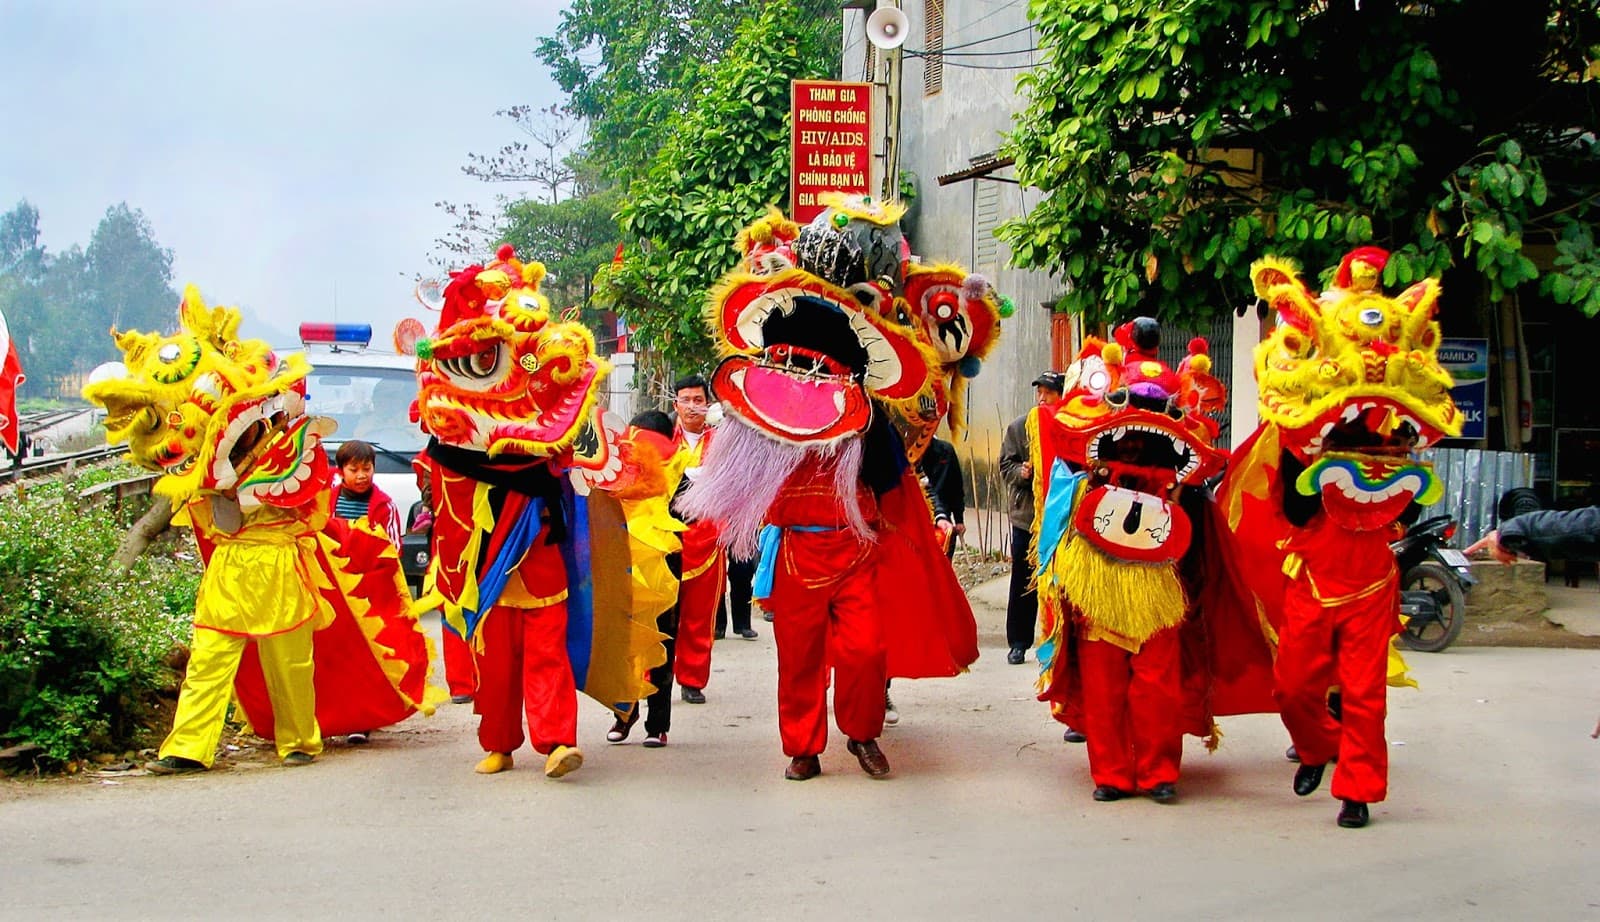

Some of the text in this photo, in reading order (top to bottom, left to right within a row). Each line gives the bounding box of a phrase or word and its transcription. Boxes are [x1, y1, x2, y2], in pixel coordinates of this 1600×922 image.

[809, 88, 856, 102] THAM GIA
[799, 106, 866, 124] PHÒNG CHỐNG
[801, 131, 867, 146] HIV/AIDS.
[808, 149, 856, 170] LÀ BẢO VỆ
[799, 170, 865, 189] CHÍNH BẠN VÀ
[799, 193, 815, 206] GIA
